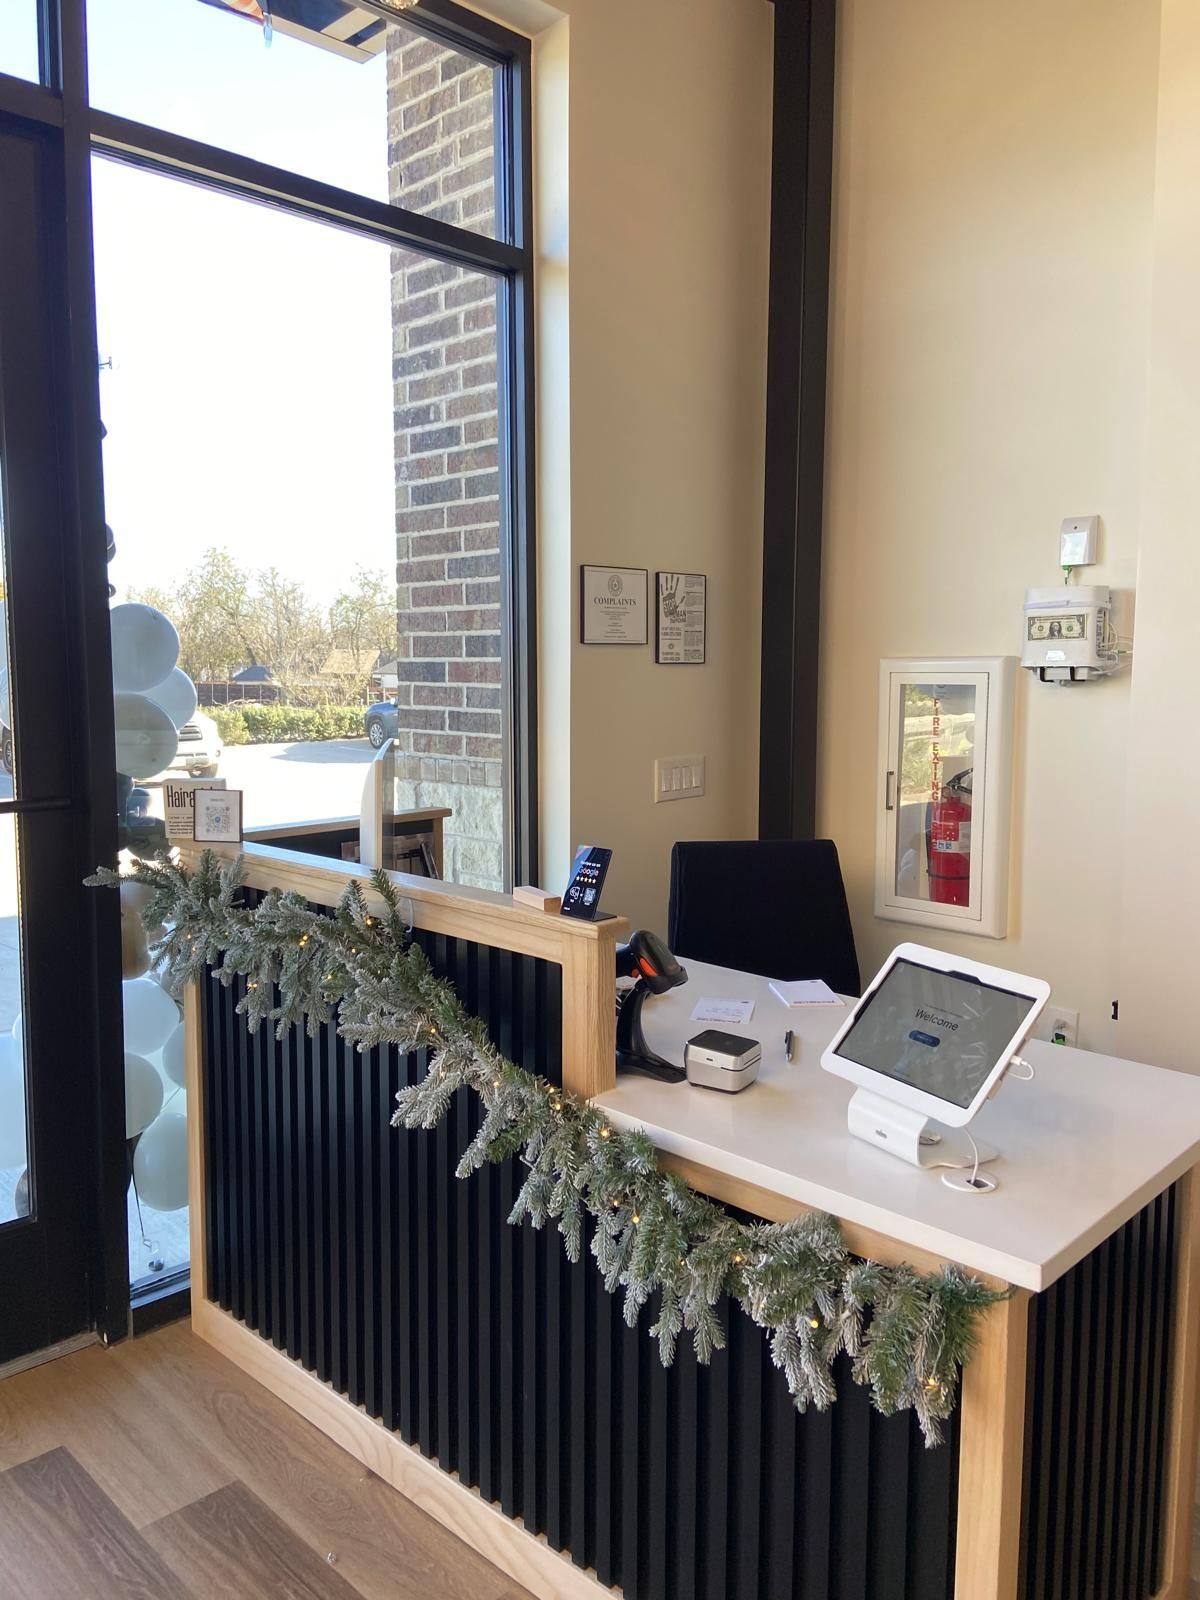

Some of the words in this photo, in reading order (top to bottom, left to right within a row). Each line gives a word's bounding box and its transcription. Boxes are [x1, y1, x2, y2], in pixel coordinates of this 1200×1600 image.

[594, 597, 637, 606] COMPLAINTS
[932, 698, 941, 736] FIRE
[577, 866, 599, 876] Google
[915, 1009, 959, 1031] Welcome
